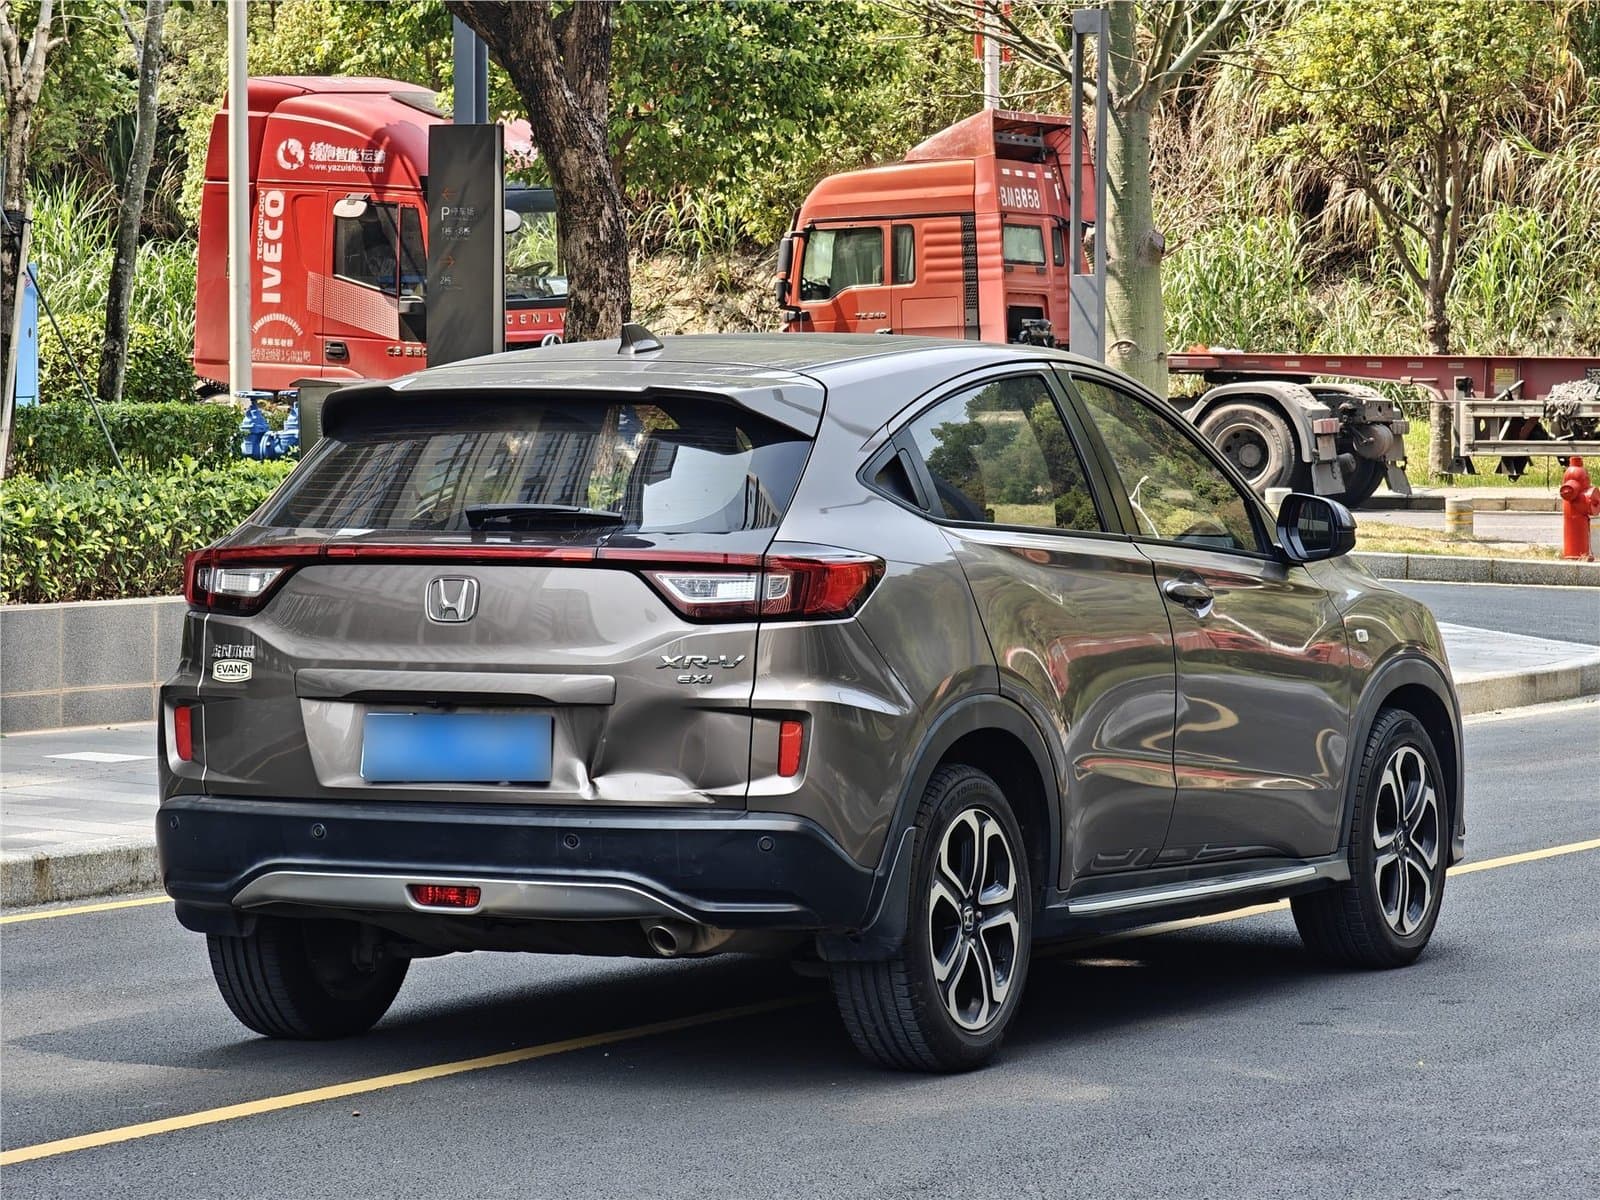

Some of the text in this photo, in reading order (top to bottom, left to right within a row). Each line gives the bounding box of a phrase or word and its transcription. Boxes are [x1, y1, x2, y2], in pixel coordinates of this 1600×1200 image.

[256, 190, 266, 261] TECHNOLOGY
[261, 190, 285, 303] IVECO
[216, 664, 248, 674] EVANS
[656, 655, 746, 669] XR-V
